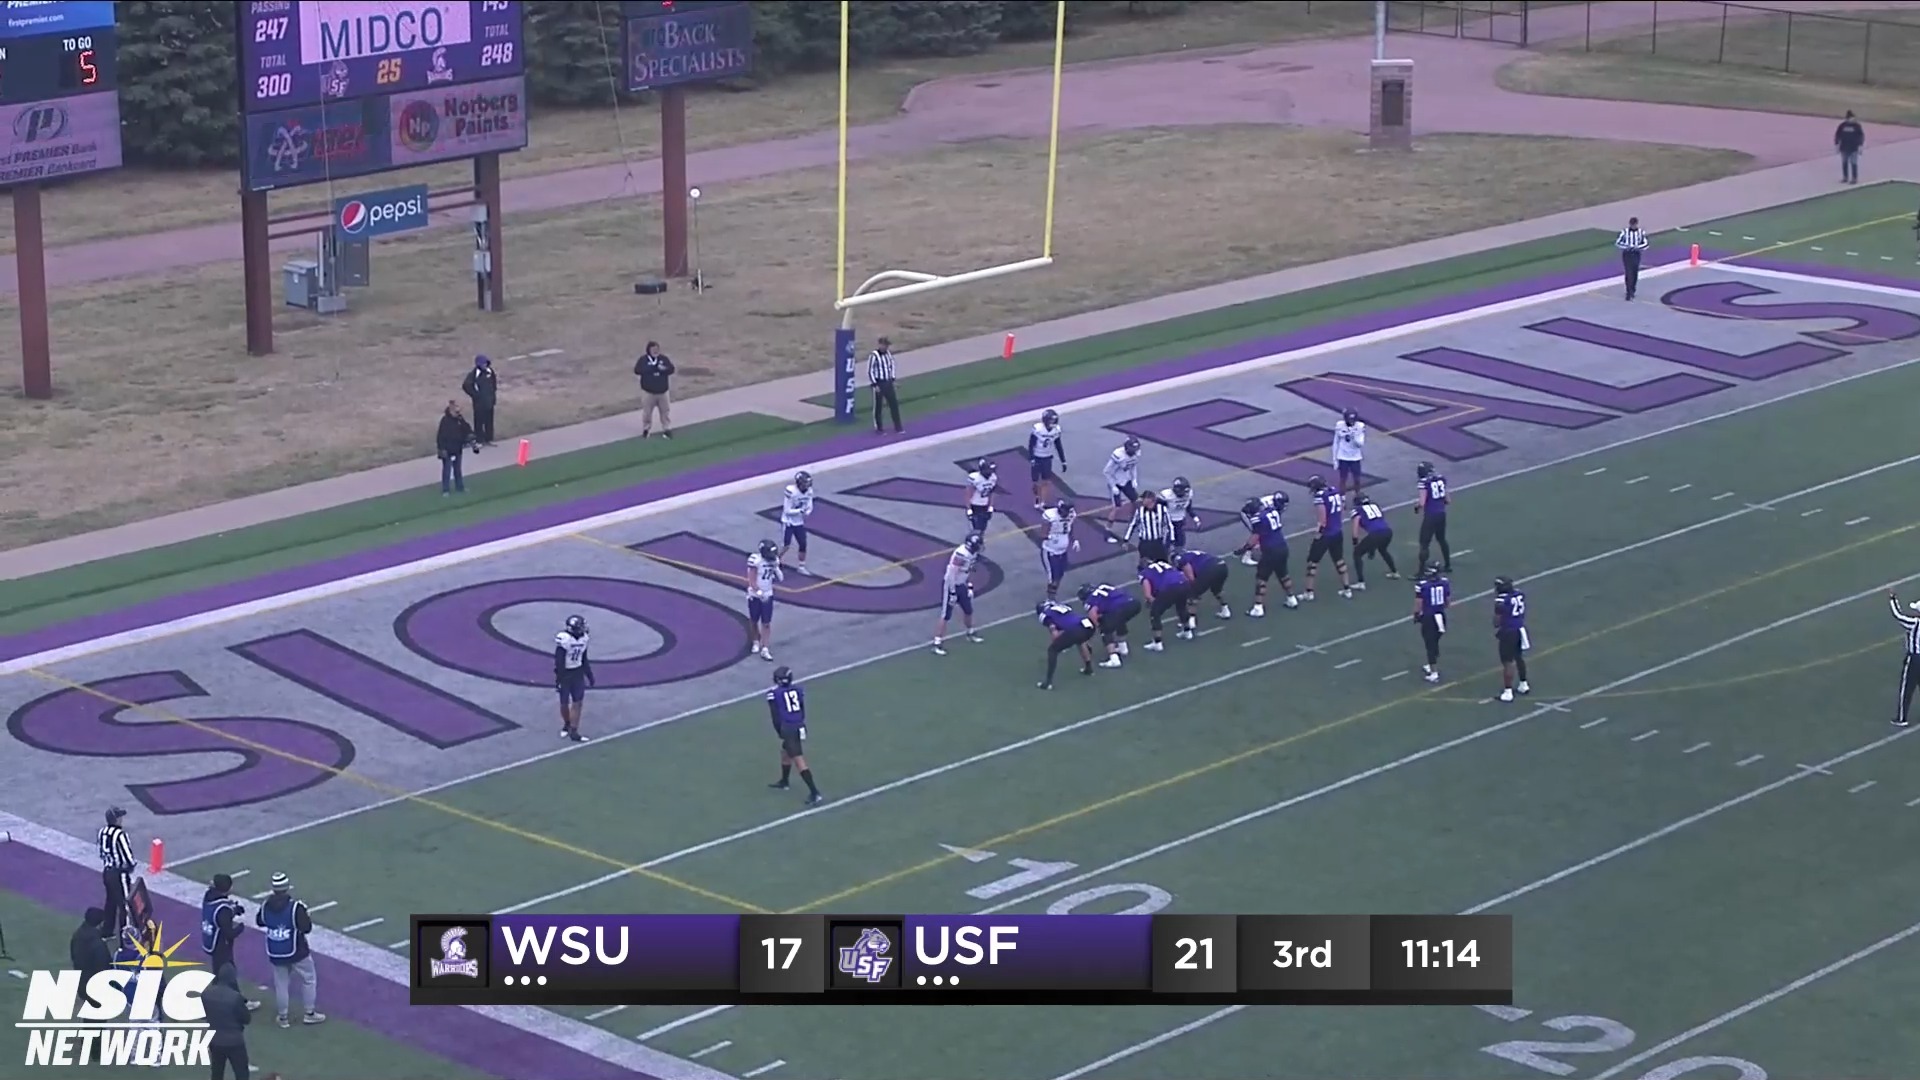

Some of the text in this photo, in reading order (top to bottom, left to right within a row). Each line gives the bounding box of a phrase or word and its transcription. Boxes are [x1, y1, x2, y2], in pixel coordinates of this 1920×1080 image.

[255, 17, 289, 43] 247
[320, 7, 442, 60] MIDCO
[485, 24, 510, 38] TOTAL
[63, 36, 92, 51] TO GO
[481, 42, 514, 67] 248
[80, 50, 98, 84] 5
[260, 54, 287, 69] TOTAL
[376, 57, 402, 85] 25
[256, 73, 292, 98] 300
[456, 115, 509, 138] Paints
[14, 145, 70, 164] PREMIER
[370, 194, 421, 227] pepsi
[1430, 480, 1446, 500] 83
[1362, 503, 1382, 520] 80
[6, 280, 1920, 815] SIOUX FALLS
[1430, 585, 1445, 606] 10
[1511, 594, 1526, 616] 25
[783, 689, 801, 713] 13
